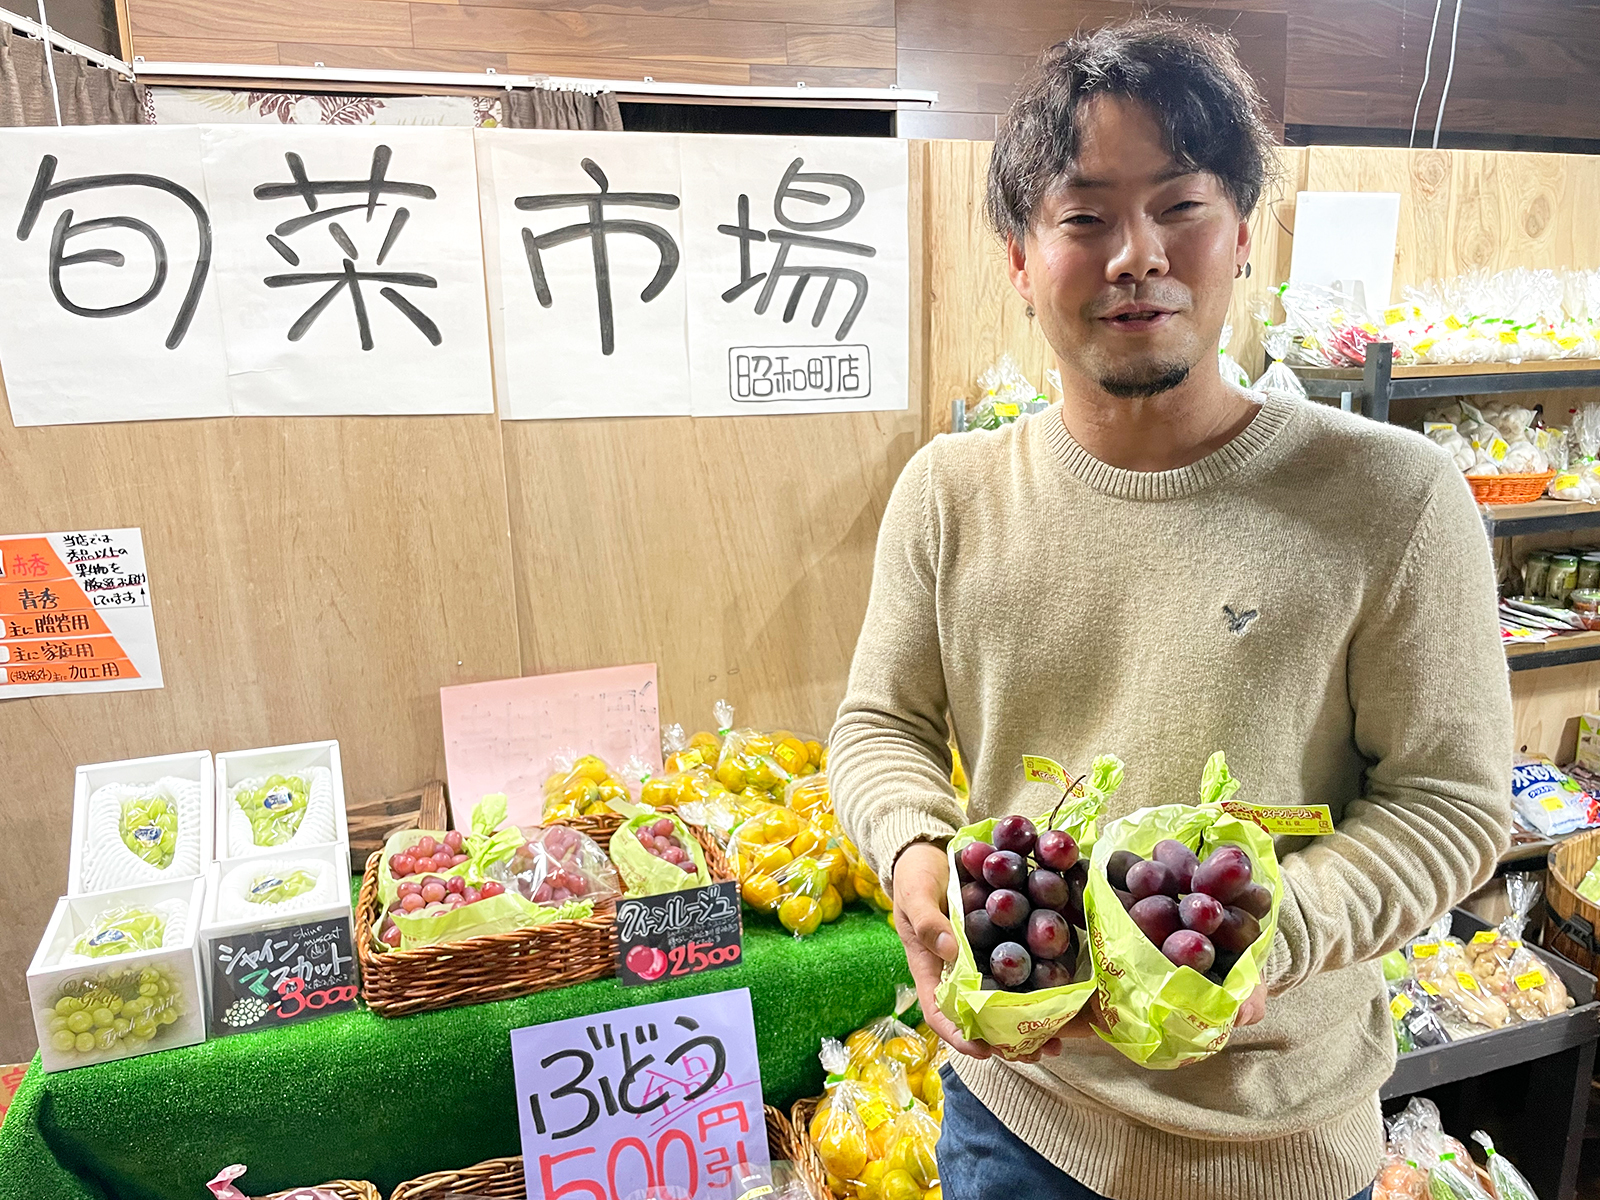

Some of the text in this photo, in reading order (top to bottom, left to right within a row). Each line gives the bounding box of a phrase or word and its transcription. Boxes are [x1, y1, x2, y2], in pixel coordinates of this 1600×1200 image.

[17, 144, 877, 355] 旬菜市場
[736, 353, 860, 398] 昭和町店
[63, 533, 113, 547] 当店では
[12, 553, 50, 577] 赤秀
[75, 562, 124, 577] 果物を
[18, 587, 60, 610] 青秀
[93, 591, 136, 606] しています
[13, 642, 95, 662] 主に家庭用
[218, 939, 299, 975] シャイン
[239, 942, 352, 998] マスカット
[668, 941, 741, 976] 2500
[276, 977, 359, 1019] 3000
[530, 1016, 726, 1140] ぶどう
